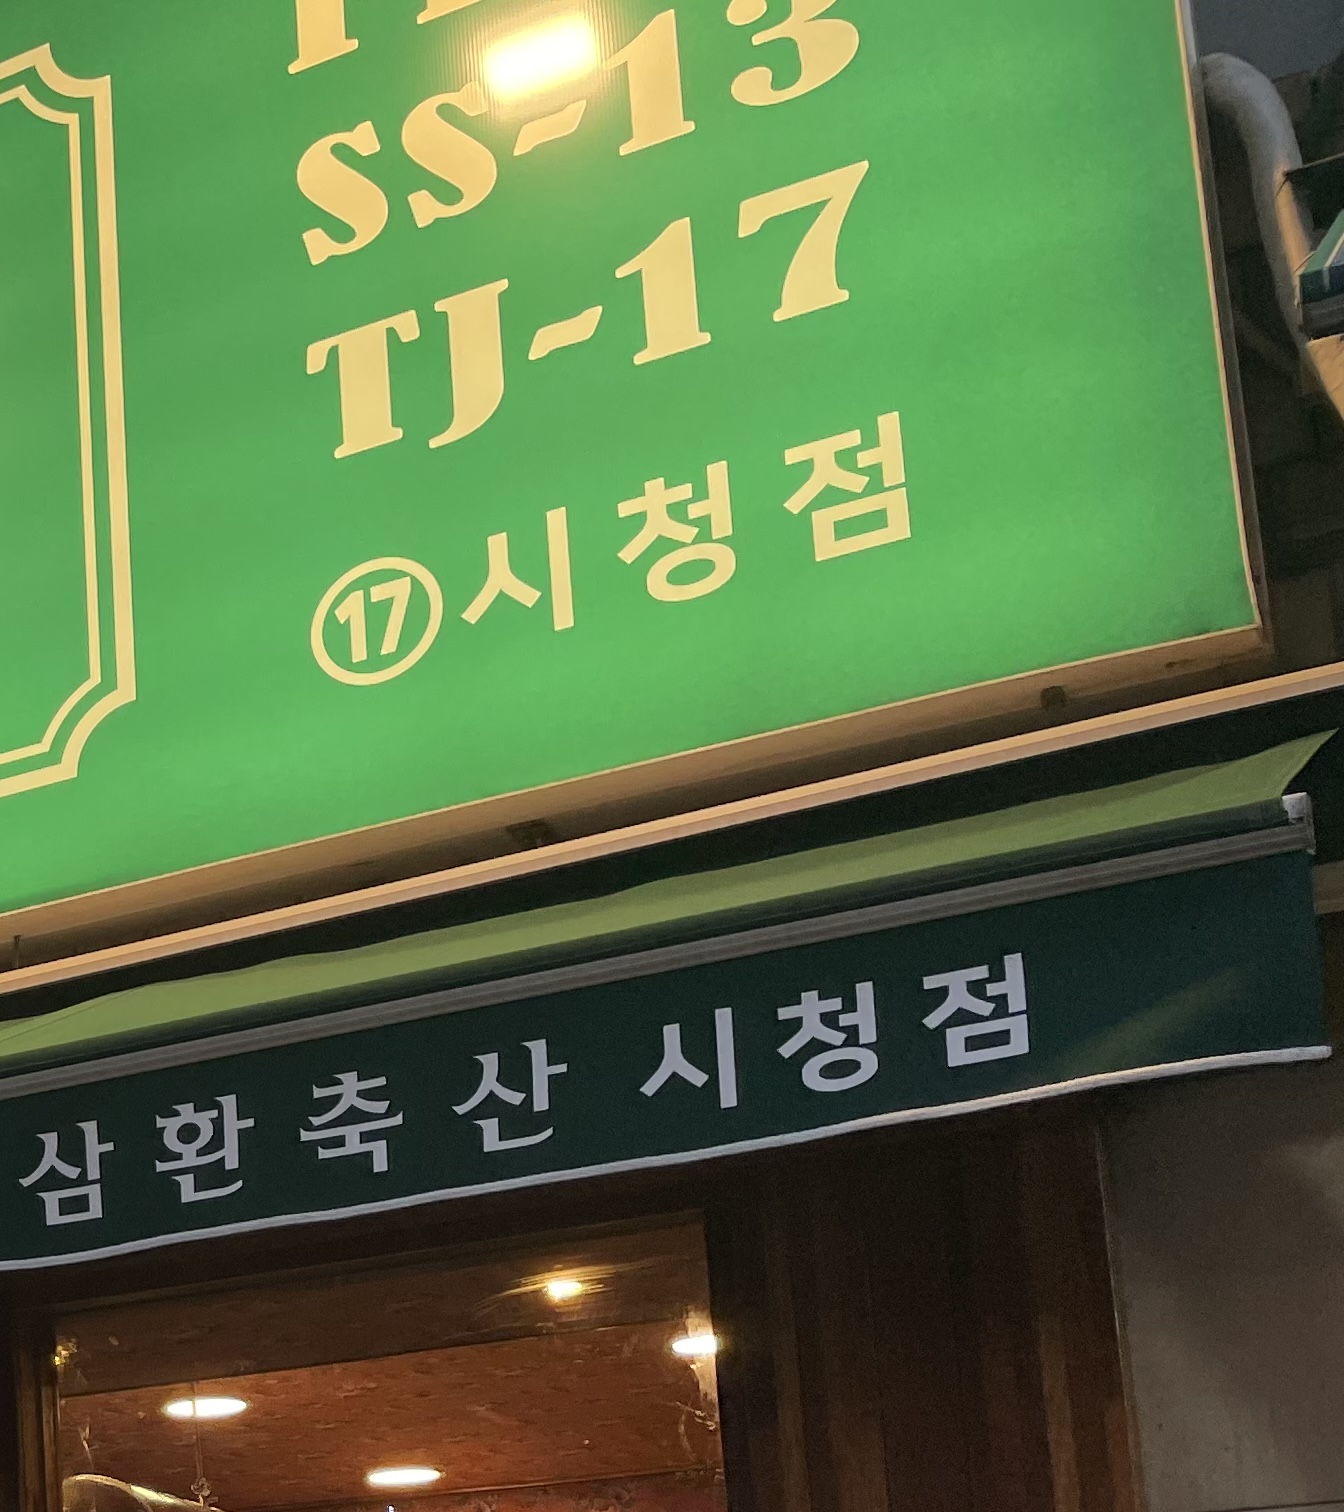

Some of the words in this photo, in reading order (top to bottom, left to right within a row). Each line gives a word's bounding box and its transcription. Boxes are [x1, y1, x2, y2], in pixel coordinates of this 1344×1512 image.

[305, 159, 870, 459] TJ-17
[460, 410, 912, 631] 시청점
[17, 1038, 569, 1229] 삼환축산
[638, 951, 1032, 1109] 시청점
